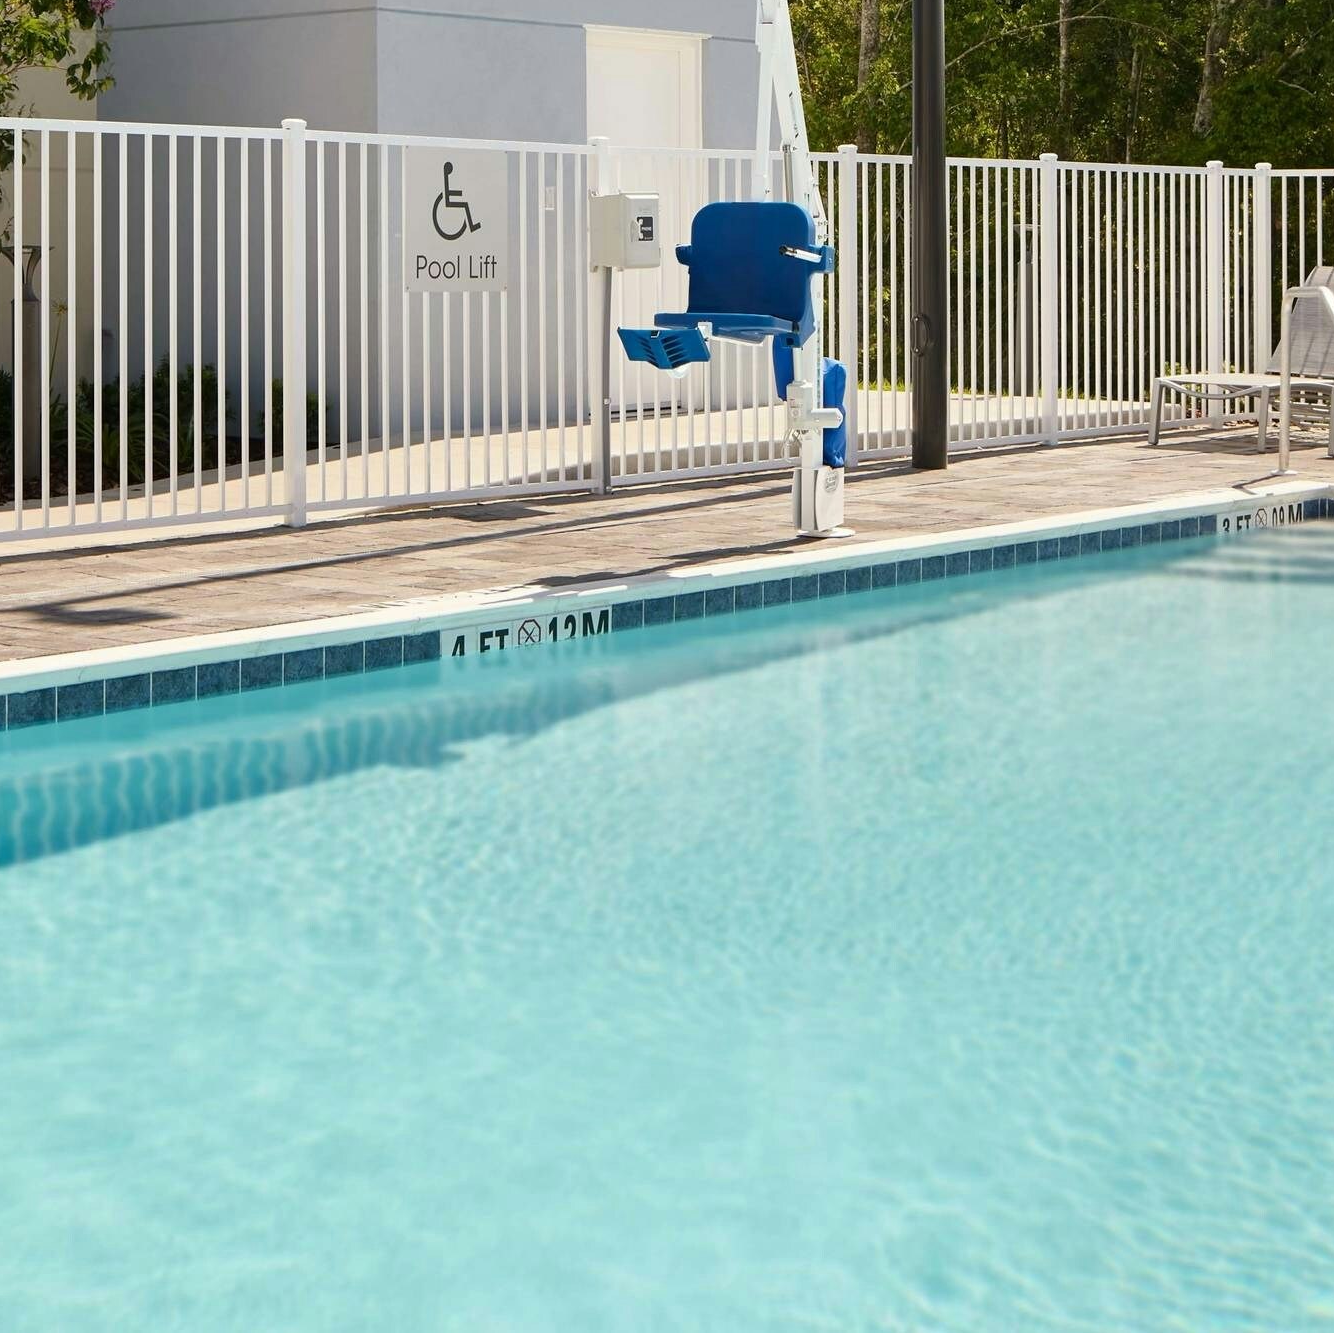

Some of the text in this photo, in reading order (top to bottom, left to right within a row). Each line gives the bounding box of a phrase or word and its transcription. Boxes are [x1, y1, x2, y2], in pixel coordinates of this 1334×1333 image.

[416, 255, 497, 279] Pool Lift
[1236, 513, 1252, 532] FT
[479, 628, 509, 653] FT
